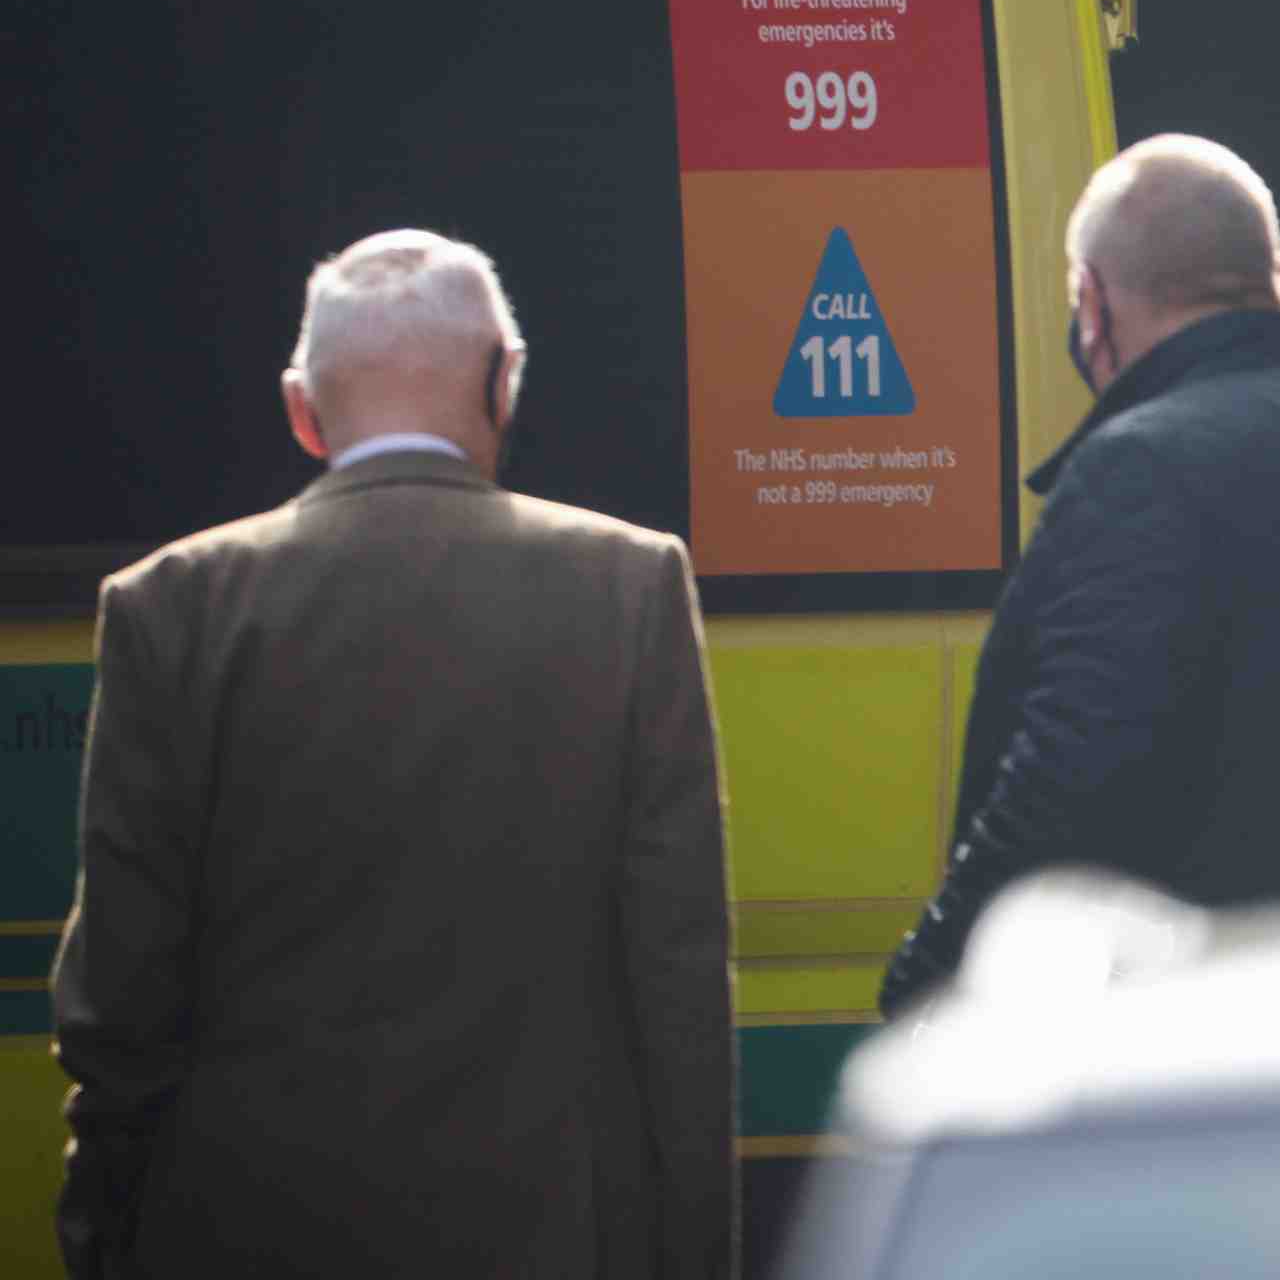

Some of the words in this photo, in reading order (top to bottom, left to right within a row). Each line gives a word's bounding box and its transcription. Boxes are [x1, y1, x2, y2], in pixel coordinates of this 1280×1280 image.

[758, 19, 867, 47] emergencies
[871, 18, 895, 40] it's
[784, 71, 878, 131] 999
[811, 294, 872, 320] CALL
[800, 335, 881, 398] 111
[734, 449, 767, 471] The
[770, 450, 807, 471] NHS
[810, 446, 874, 470] number
[879, 446, 928, 468] when
[931, 446, 956, 467] it's
[756, 483, 788, 504] not
[790, 488, 802, 503] a
[805, 481, 837, 503] 999
[840, 481, 934, 506] emergency
